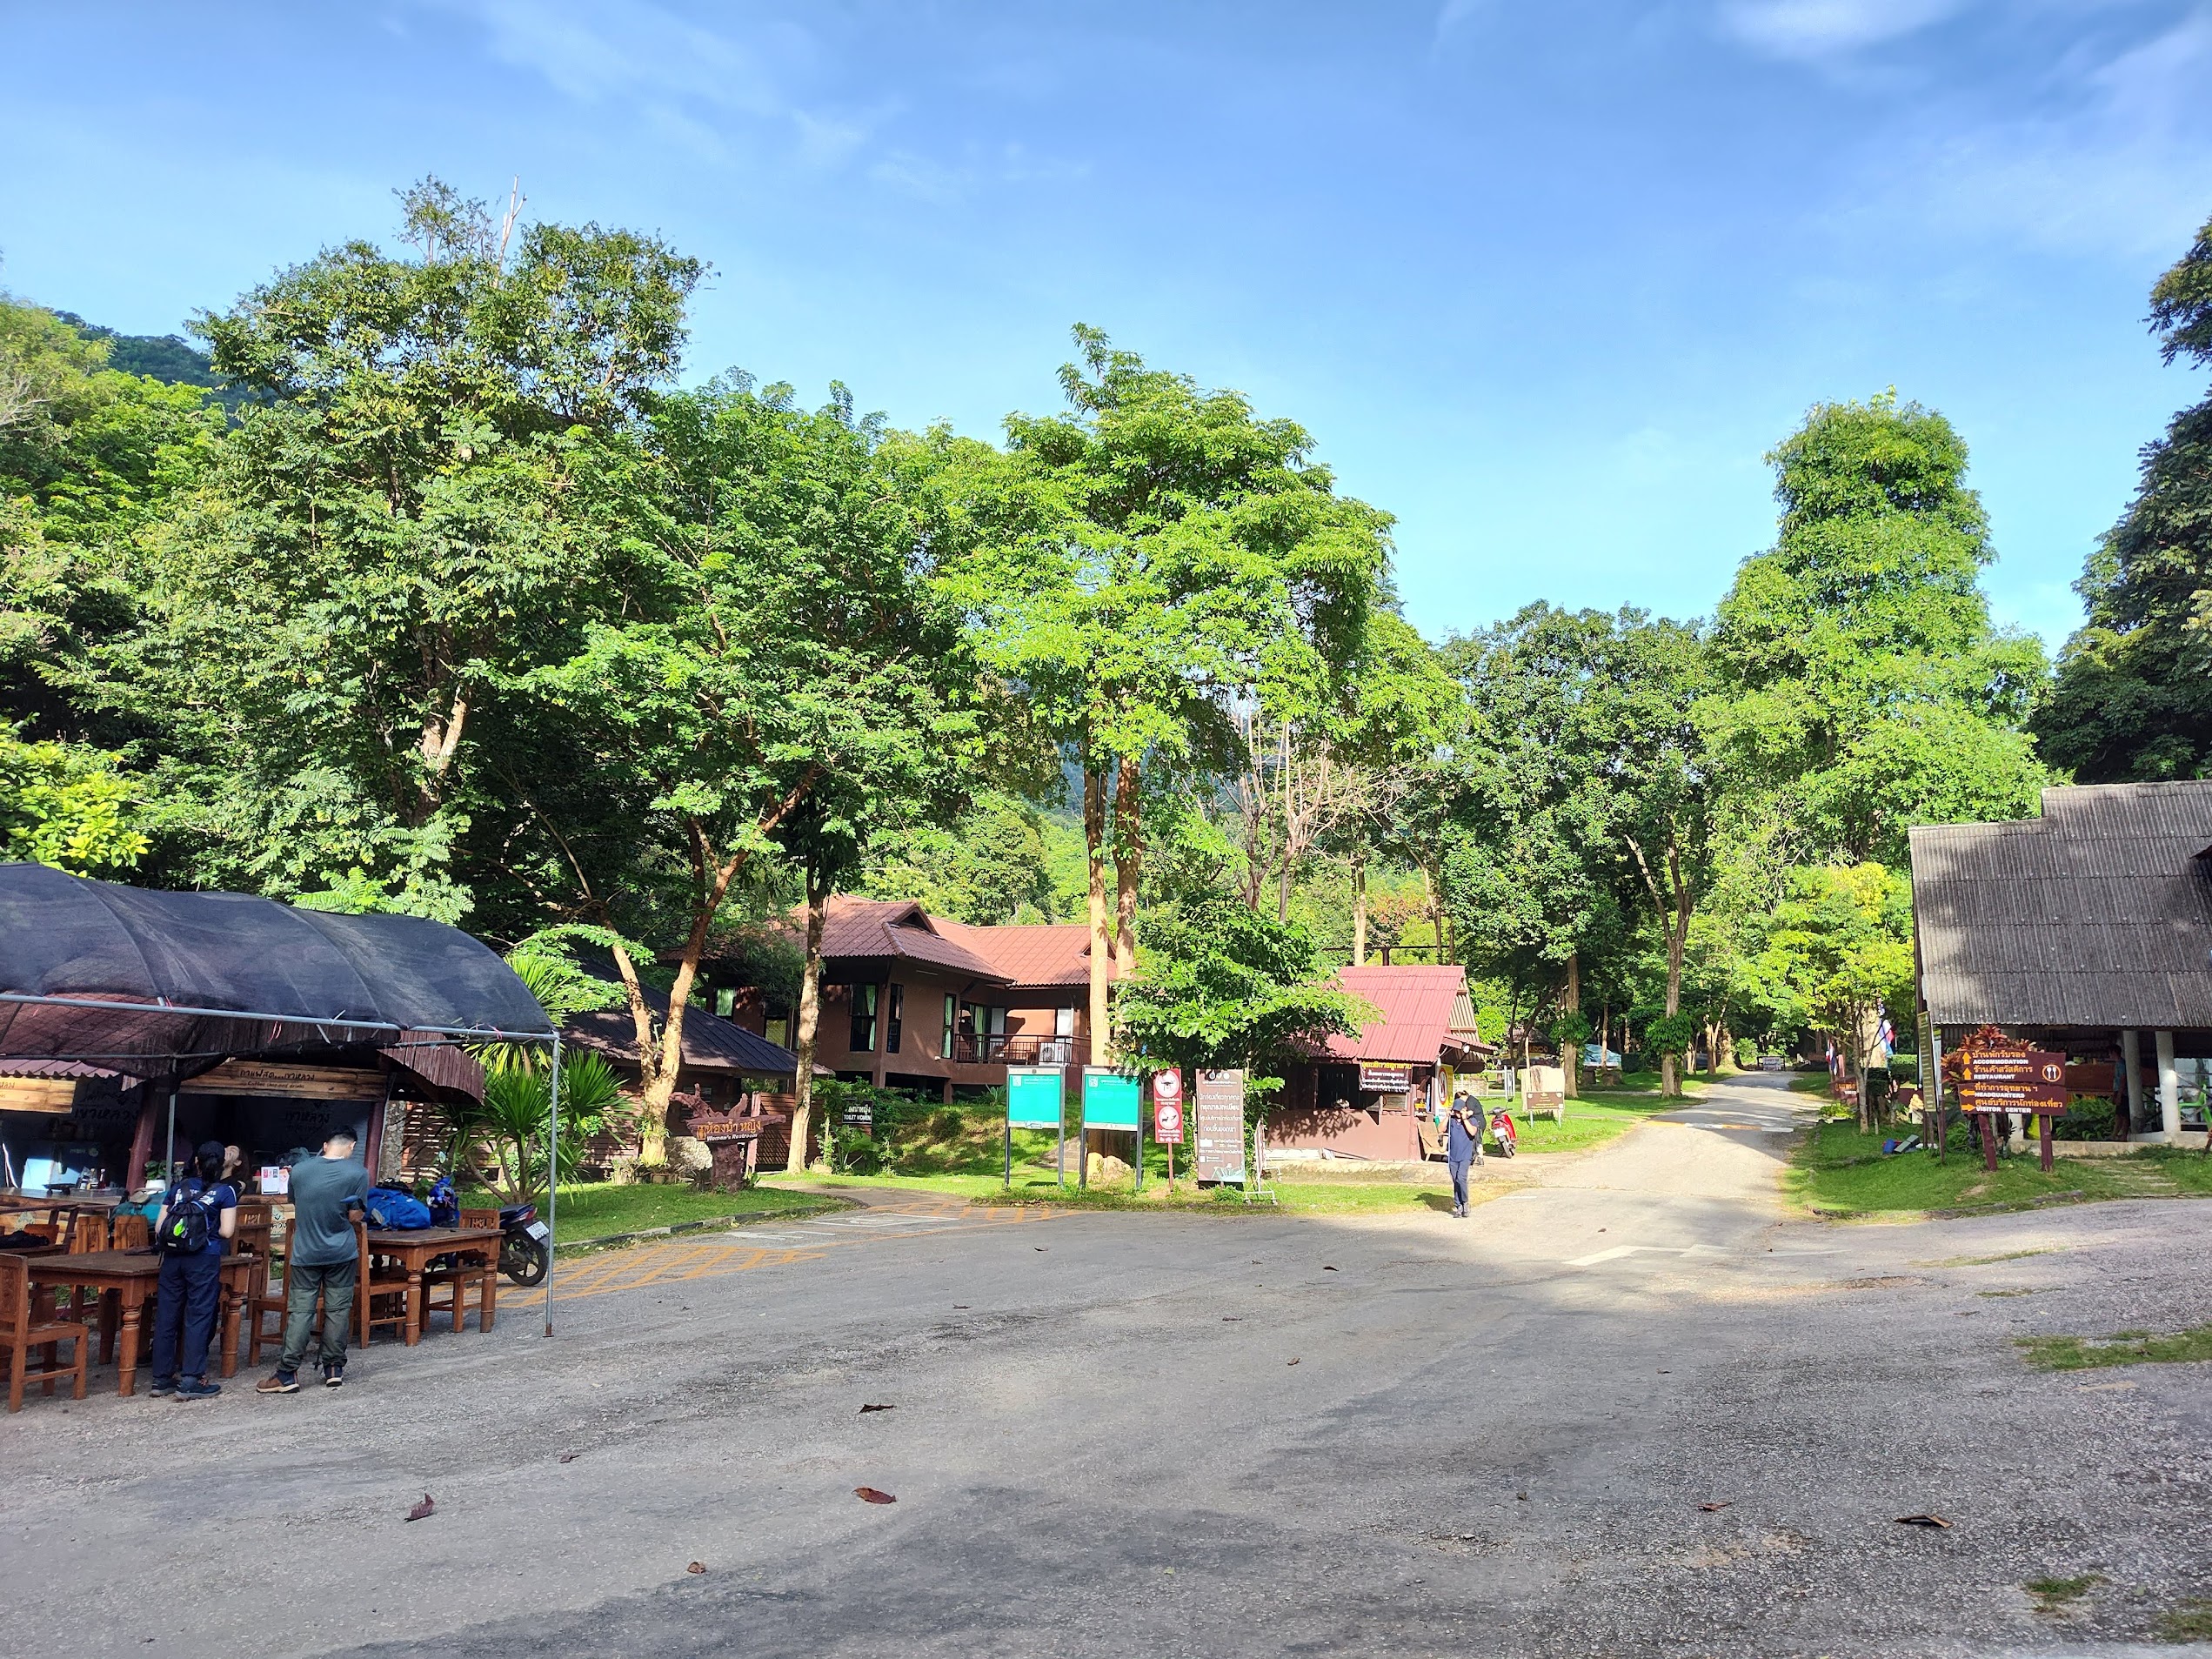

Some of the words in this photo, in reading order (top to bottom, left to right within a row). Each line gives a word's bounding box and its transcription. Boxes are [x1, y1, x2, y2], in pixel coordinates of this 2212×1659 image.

[1972, 1050, 2026, 1059] บ้านพักรับรอง
[1973, 1065, 2034, 1074] ร้านค้าสวัสดิการ
[1975, 1097, 2063, 1108] ศูนย์บริการนักท่องเที่ยว
[705, 1119, 738, 1134] ห้องน้ำ
[739, 1119, 761, 1134] หญิง
